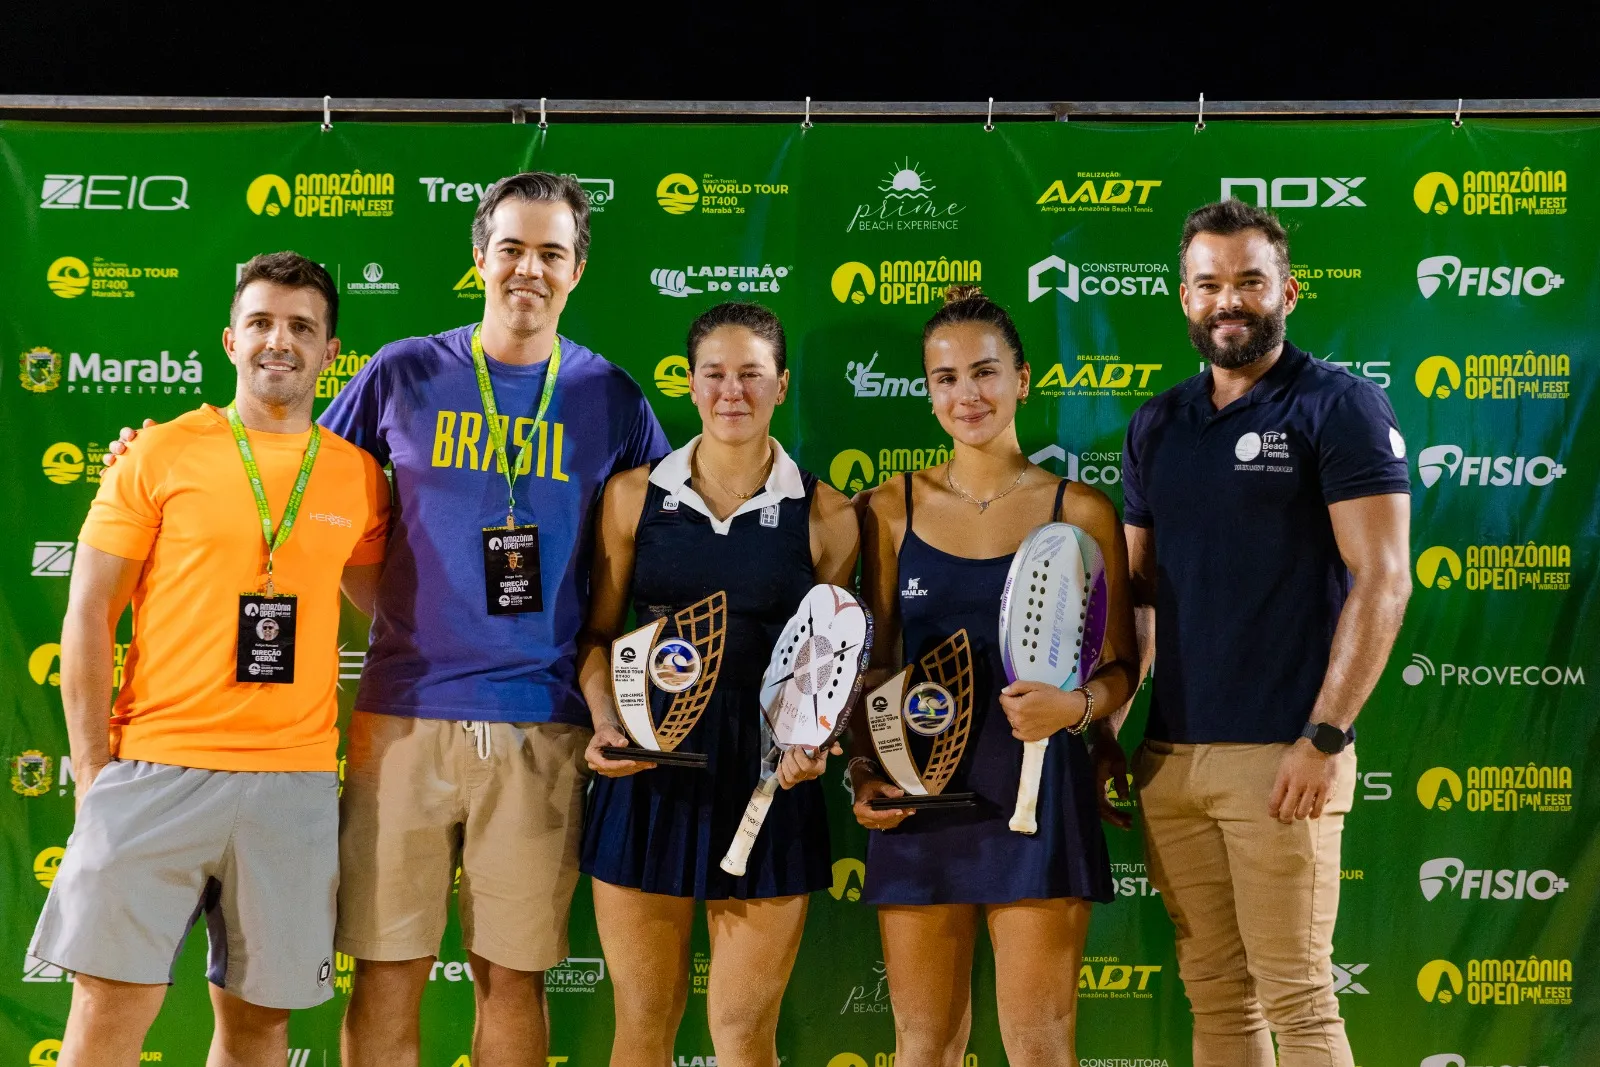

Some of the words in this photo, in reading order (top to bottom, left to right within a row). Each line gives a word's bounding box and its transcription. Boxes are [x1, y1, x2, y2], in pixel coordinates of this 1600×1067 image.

[295, 168, 394, 195] AMAZÔNIA
[419, 177, 502, 202] Trev
[703, 184, 752, 194] WORLD
[754, 184, 788, 194] TOUR
[1463, 166, 1566, 192] AMAZÔNIA
[40, 174, 190, 210] ZEIQ
[702, 196, 738, 206] BT400
[294, 196, 343, 217] OPEN
[345, 197, 365, 216] FAN
[368, 200, 394, 210] FEST
[1463, 194, 1514, 215] OPEN
[1515, 195, 1536, 215] FAN
[1540, 197, 1567, 208] FEST
[846, 201, 966, 233] prime
[859, 220, 894, 230] BEACH
[897, 220, 959, 230] EXPERIENCE
[93, 268, 142, 277] WORLD
[144, 268, 179, 278] TOUR
[687, 264, 788, 278] LADEIRÃO
[880, 256, 982, 282] AMAZÔNIA
[1082, 262, 1170, 273] CONSTRUTORA
[1326, 269, 1361, 279] TOUR
[92, 280, 128, 290] BT400
[708, 281, 732, 292] DO
[880, 282, 929, 304] OPEN
[930, 286, 946, 300] FA
[1081, 276, 1169, 296] COSTA
[458, 292, 482, 300] Amigos
[68, 350, 204, 383] Marabá
[1466, 350, 1570, 376] AMAZÔNIA
[68, 386, 202, 395] PREFEITURA
[315, 376, 339, 398] EN
[858, 372, 928, 397] Sma
[1466, 377, 1516, 400] OPEN
[1518, 378, 1540, 400] FAN
[1543, 382, 1570, 392] FEST
[432, 410, 570, 482] BRASIL
[1263, 434, 1279, 443] ITF
[878, 444, 955, 470] AMAZÔ
[1262, 450, 1289, 458] Tennis
[1466, 541, 1571, 568] AMAZÔNIA
[500, 580, 529, 588] DIREÇÃO
[1466, 568, 1517, 590] OPEN
[1518, 570, 1540, 590] FAN
[1544, 572, 1570, 583] FEST
[260, 603, 291, 611] AMAZÔNIA
[1441, 663, 1585, 686] PROVECOM
[1468, 762, 1572, 789] AMAZÔNIA
[1468, 789, 1518, 811] OPEN
[1520, 791, 1541, 811] FAN
[1544, 794, 1572, 805] FEST
[1339, 869, 1364, 880] OUR
[546, 970, 598, 986] NTRO
[1079, 964, 1162, 990] ABT
[1468, 955, 1572, 982] AMAZÔNIA
[1468, 982, 1519, 1005] OPEN
[1521, 984, 1542, 1005] FAN
[1545, 987, 1572, 998] FEST
[854, 1004, 888, 1012] BEACH
